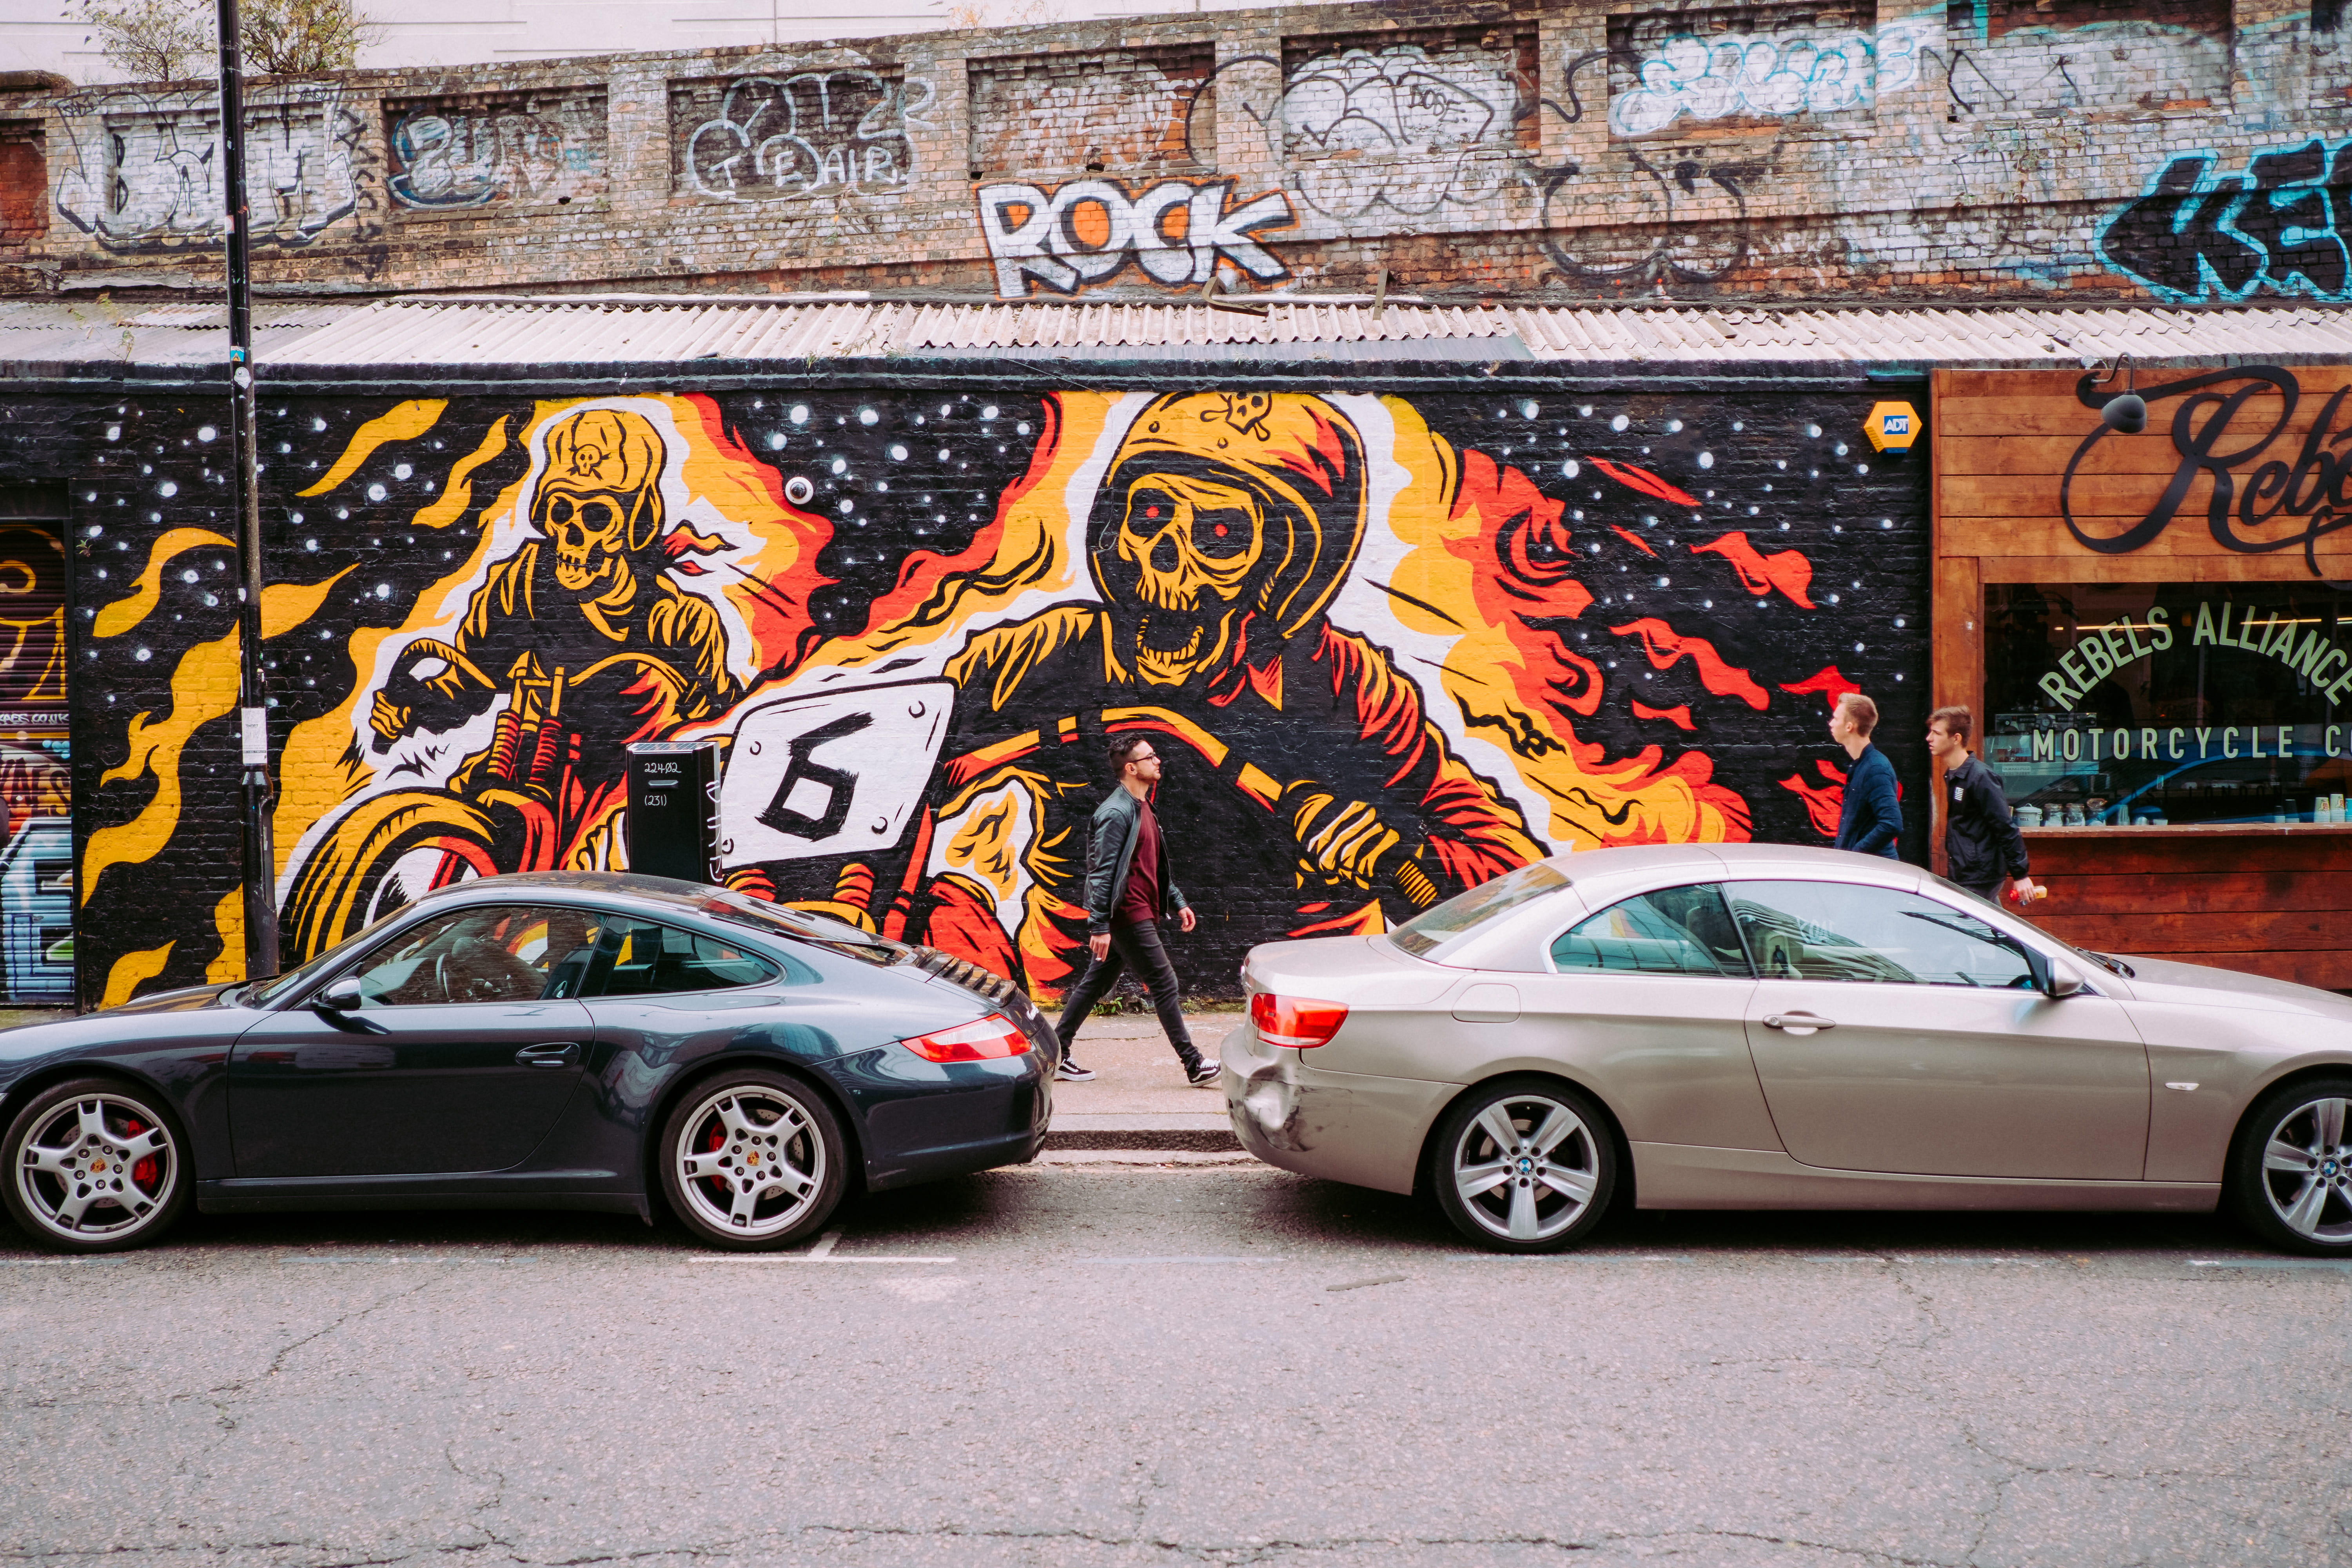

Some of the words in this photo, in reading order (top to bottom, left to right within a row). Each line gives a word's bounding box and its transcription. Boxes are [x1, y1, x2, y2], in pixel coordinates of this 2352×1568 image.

[971, 174, 1300, 301] ROCK
[1884, 418, 1909, 432] ADT
[2038, 606, 2173, 711] REBELS
[2193, 602, 2352, 706] ALLIANCE
[2033, 726, 2293, 761] MOTORCYCLE
[2325, 725, 2352, 757] C
[644, 762, 682, 774] 22402
[755, 711, 874, 842] 6
[644, 794, 667, 806] (231)
